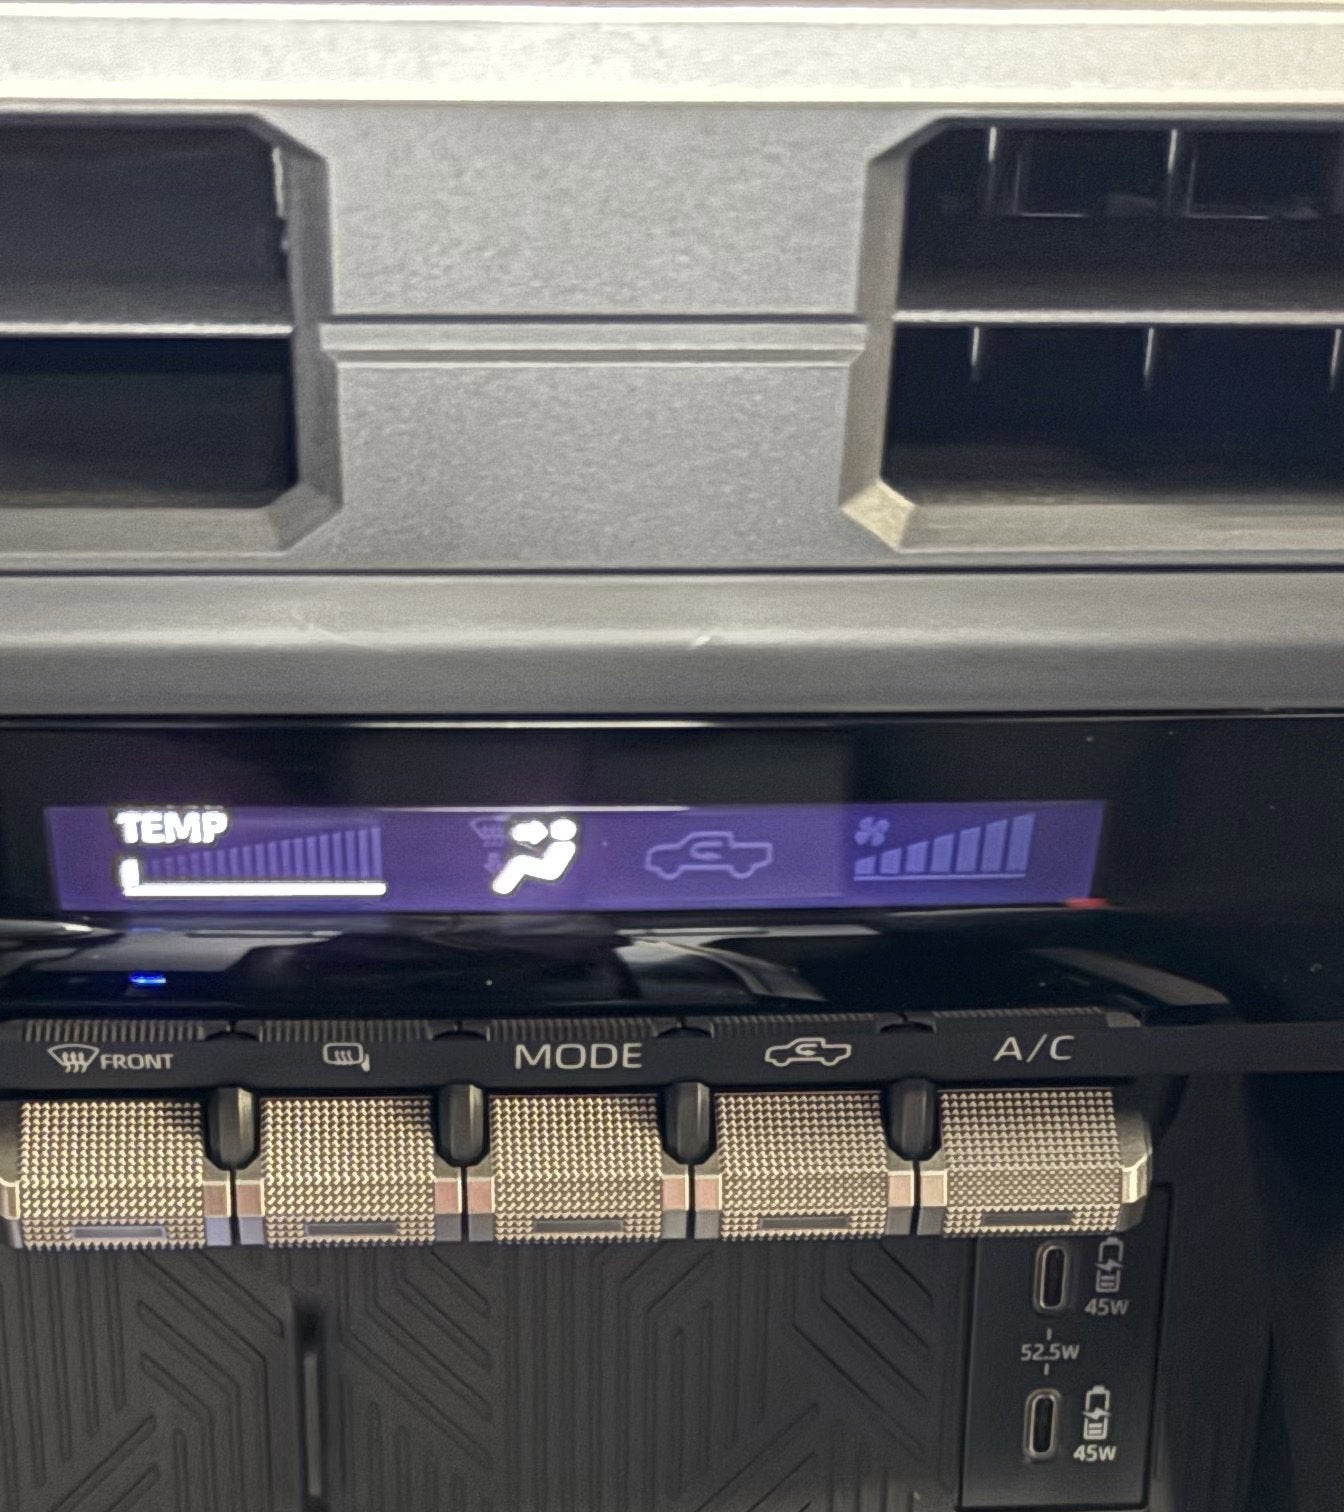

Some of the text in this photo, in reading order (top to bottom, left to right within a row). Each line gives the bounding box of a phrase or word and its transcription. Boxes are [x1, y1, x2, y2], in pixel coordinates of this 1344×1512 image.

[115, 809, 229, 845] TEMP
[513, 1041, 644, 1070] MODE
[993, 1034, 1076, 1062] A/C
[100, 1052, 174, 1071] FRONT
[1084, 1298, 1129, 1316] 45W
[1020, 1344, 1080, 1361] 52.5W
[1073, 1445, 1116, 1462] 45W
